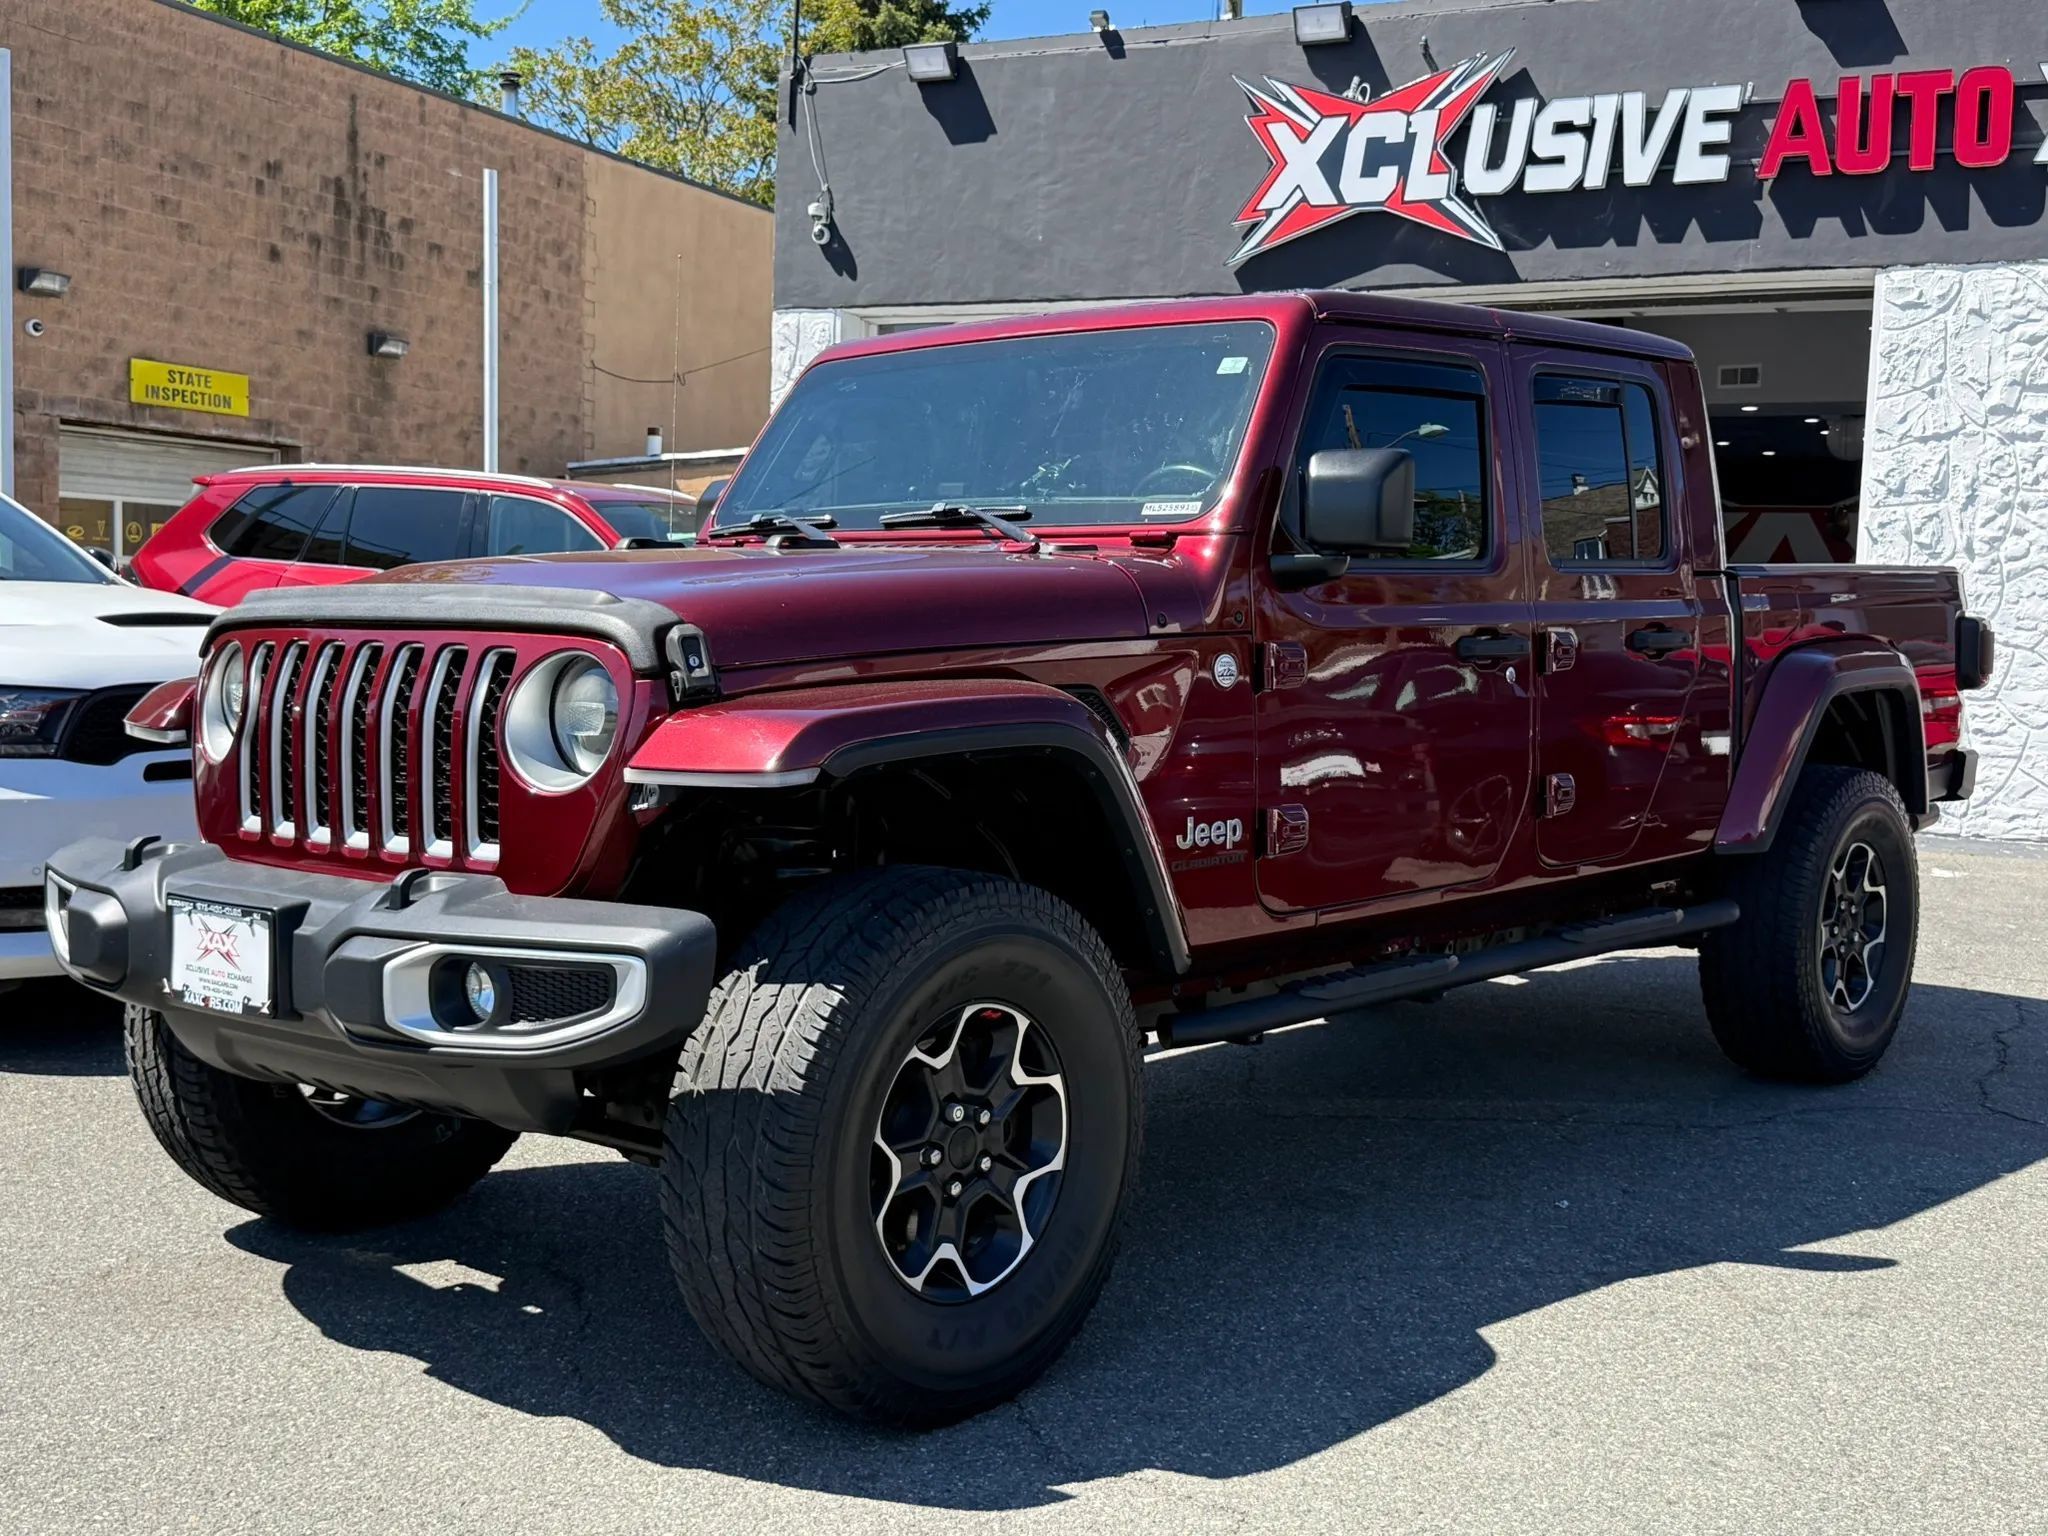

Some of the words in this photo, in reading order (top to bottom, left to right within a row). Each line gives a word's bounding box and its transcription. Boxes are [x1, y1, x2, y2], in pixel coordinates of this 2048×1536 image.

[1255, 83, 1744, 211] XCLUSIVE
[1756, 65, 2014, 179] AUTO
[167, 369, 212, 389] STATE
[145, 384, 232, 409] INSPECTION
[1176, 816, 1243, 850] Jeep
[1171, 853, 1244, 871] GLADIATOR
[197, 928, 240, 957] XAX
[211, 969, 226, 979] AUTO
